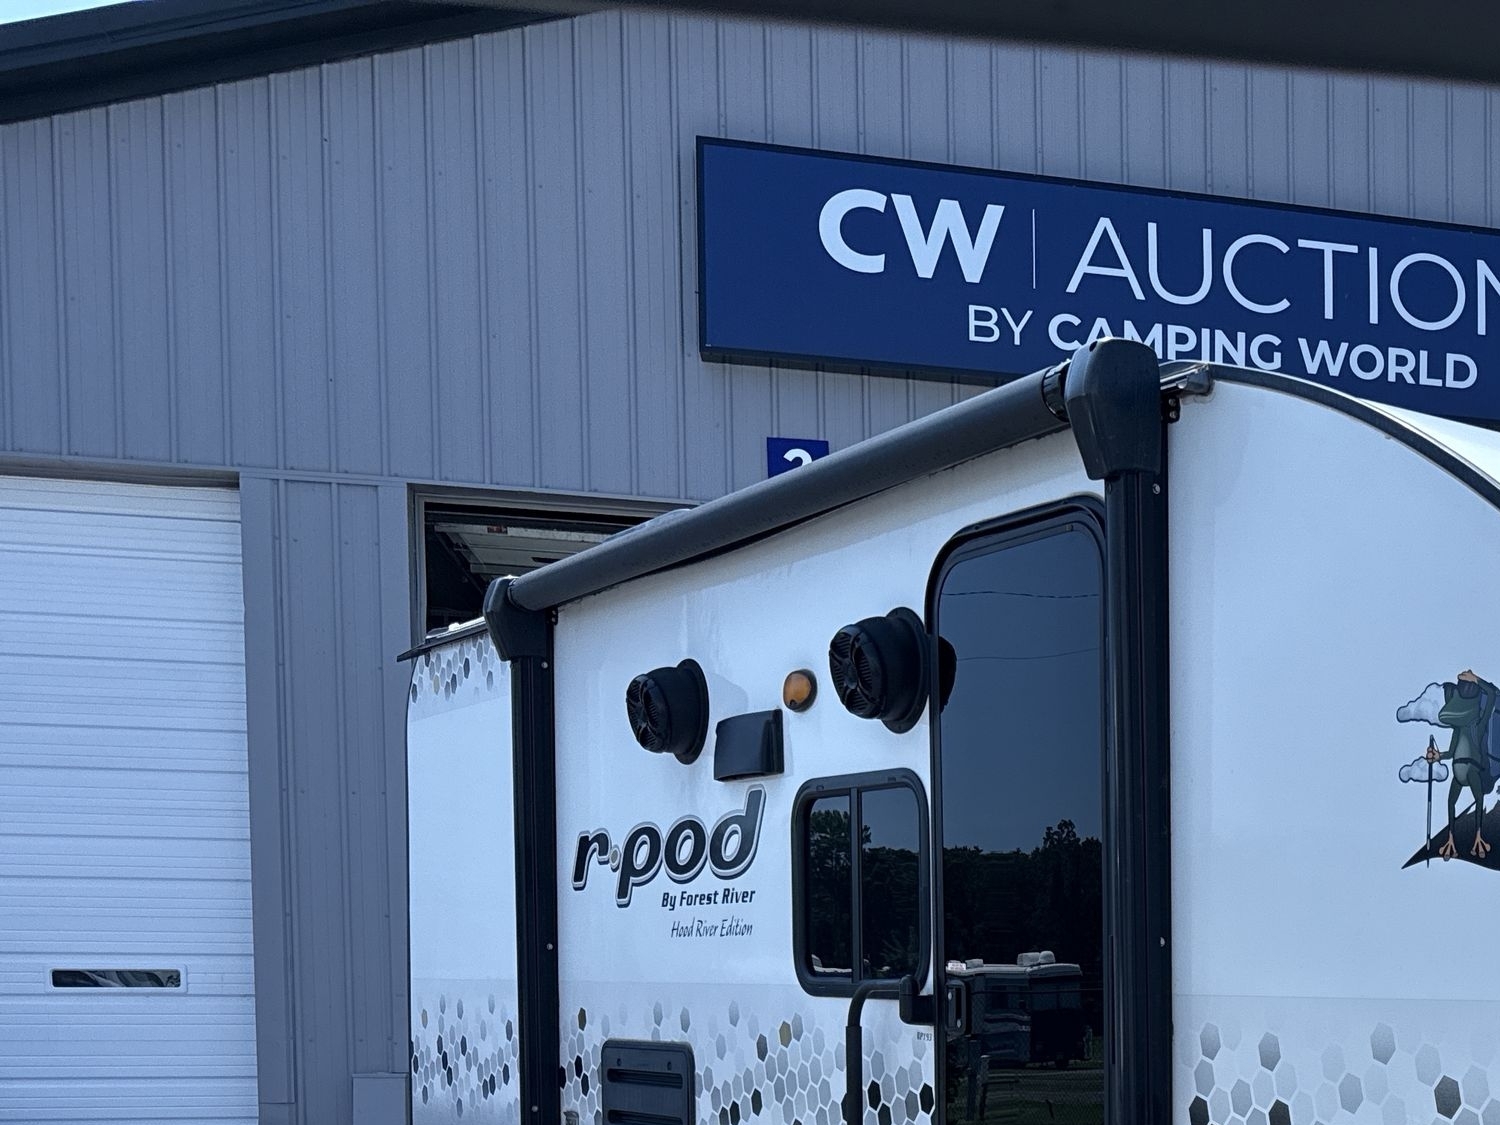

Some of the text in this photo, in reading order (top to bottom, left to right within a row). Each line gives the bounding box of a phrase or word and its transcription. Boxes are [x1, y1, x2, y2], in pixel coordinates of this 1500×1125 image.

[818, 188, 1005, 284] CW
[968, 304, 1479, 390] BY CAMPING WORLD
[661, 887, 756, 911] By Forest River
[670, 914, 753, 938] Hood River Edition
